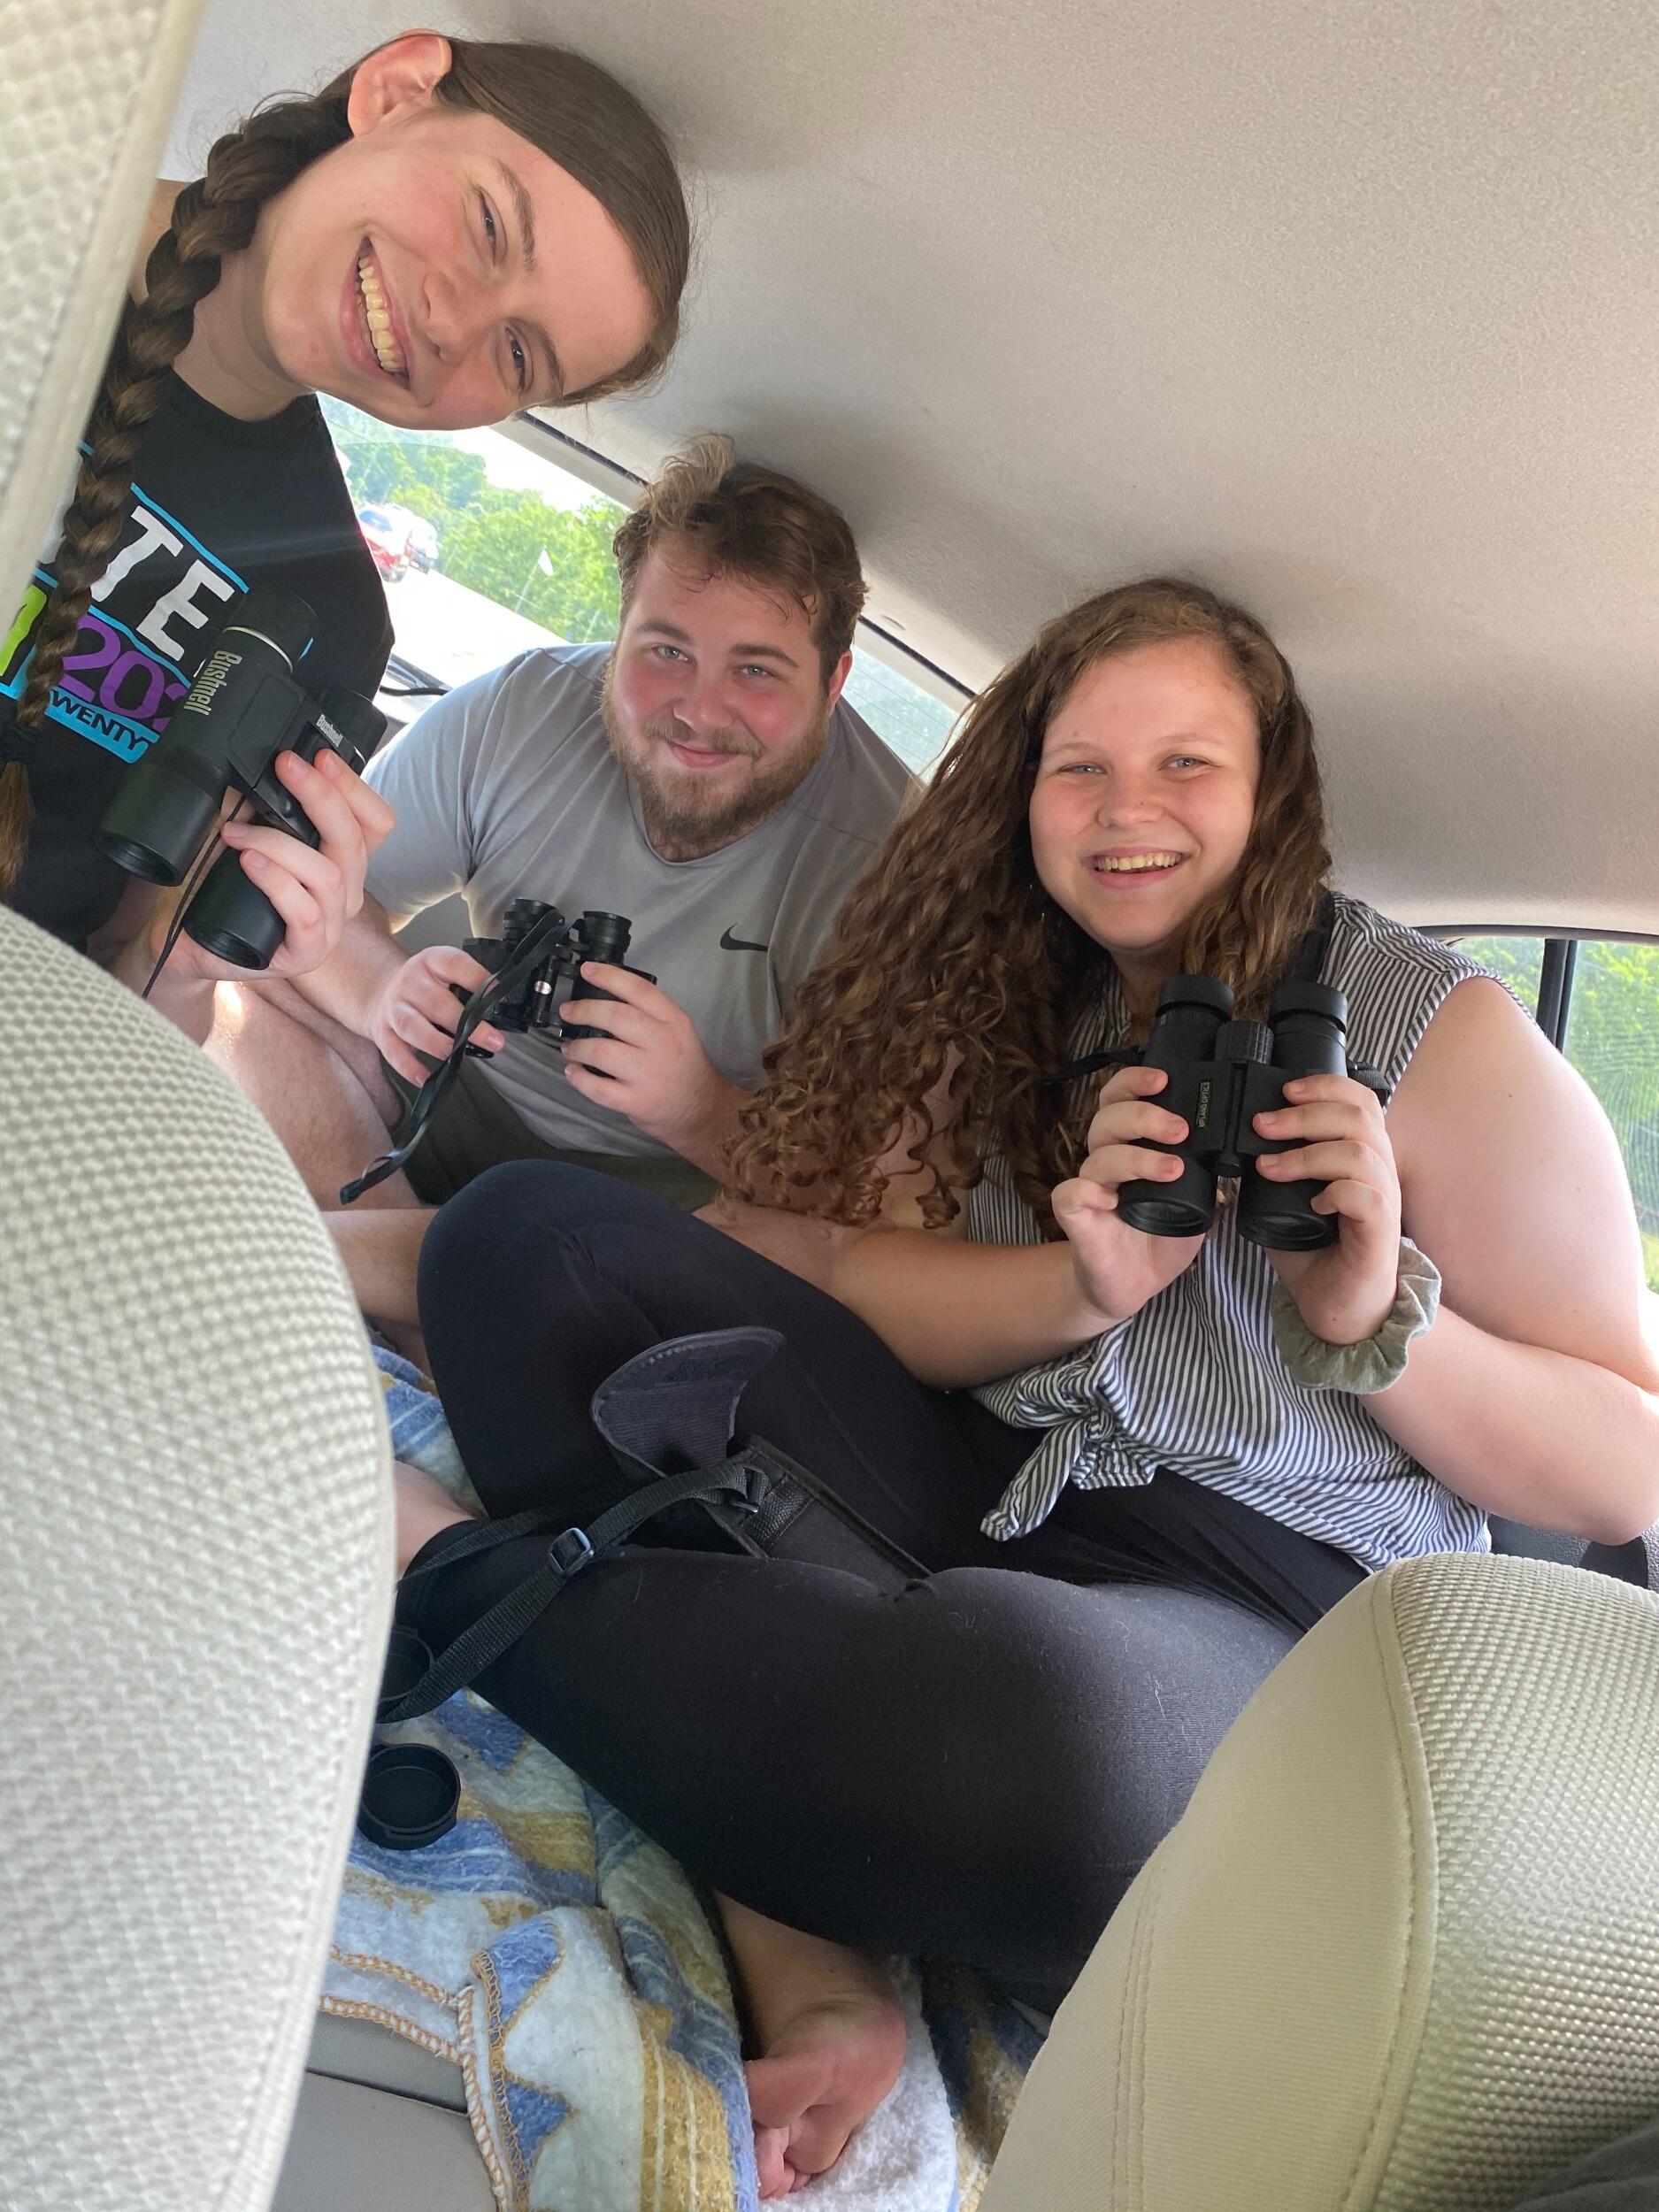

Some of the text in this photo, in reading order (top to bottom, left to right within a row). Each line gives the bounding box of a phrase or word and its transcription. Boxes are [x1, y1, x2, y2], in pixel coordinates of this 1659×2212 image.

[90, 505, 235, 662] TE
[183, 649, 242, 716] Bushnell
[50, 689, 150, 751] WENTY
[316, 713, 343, 748] Bushnell
